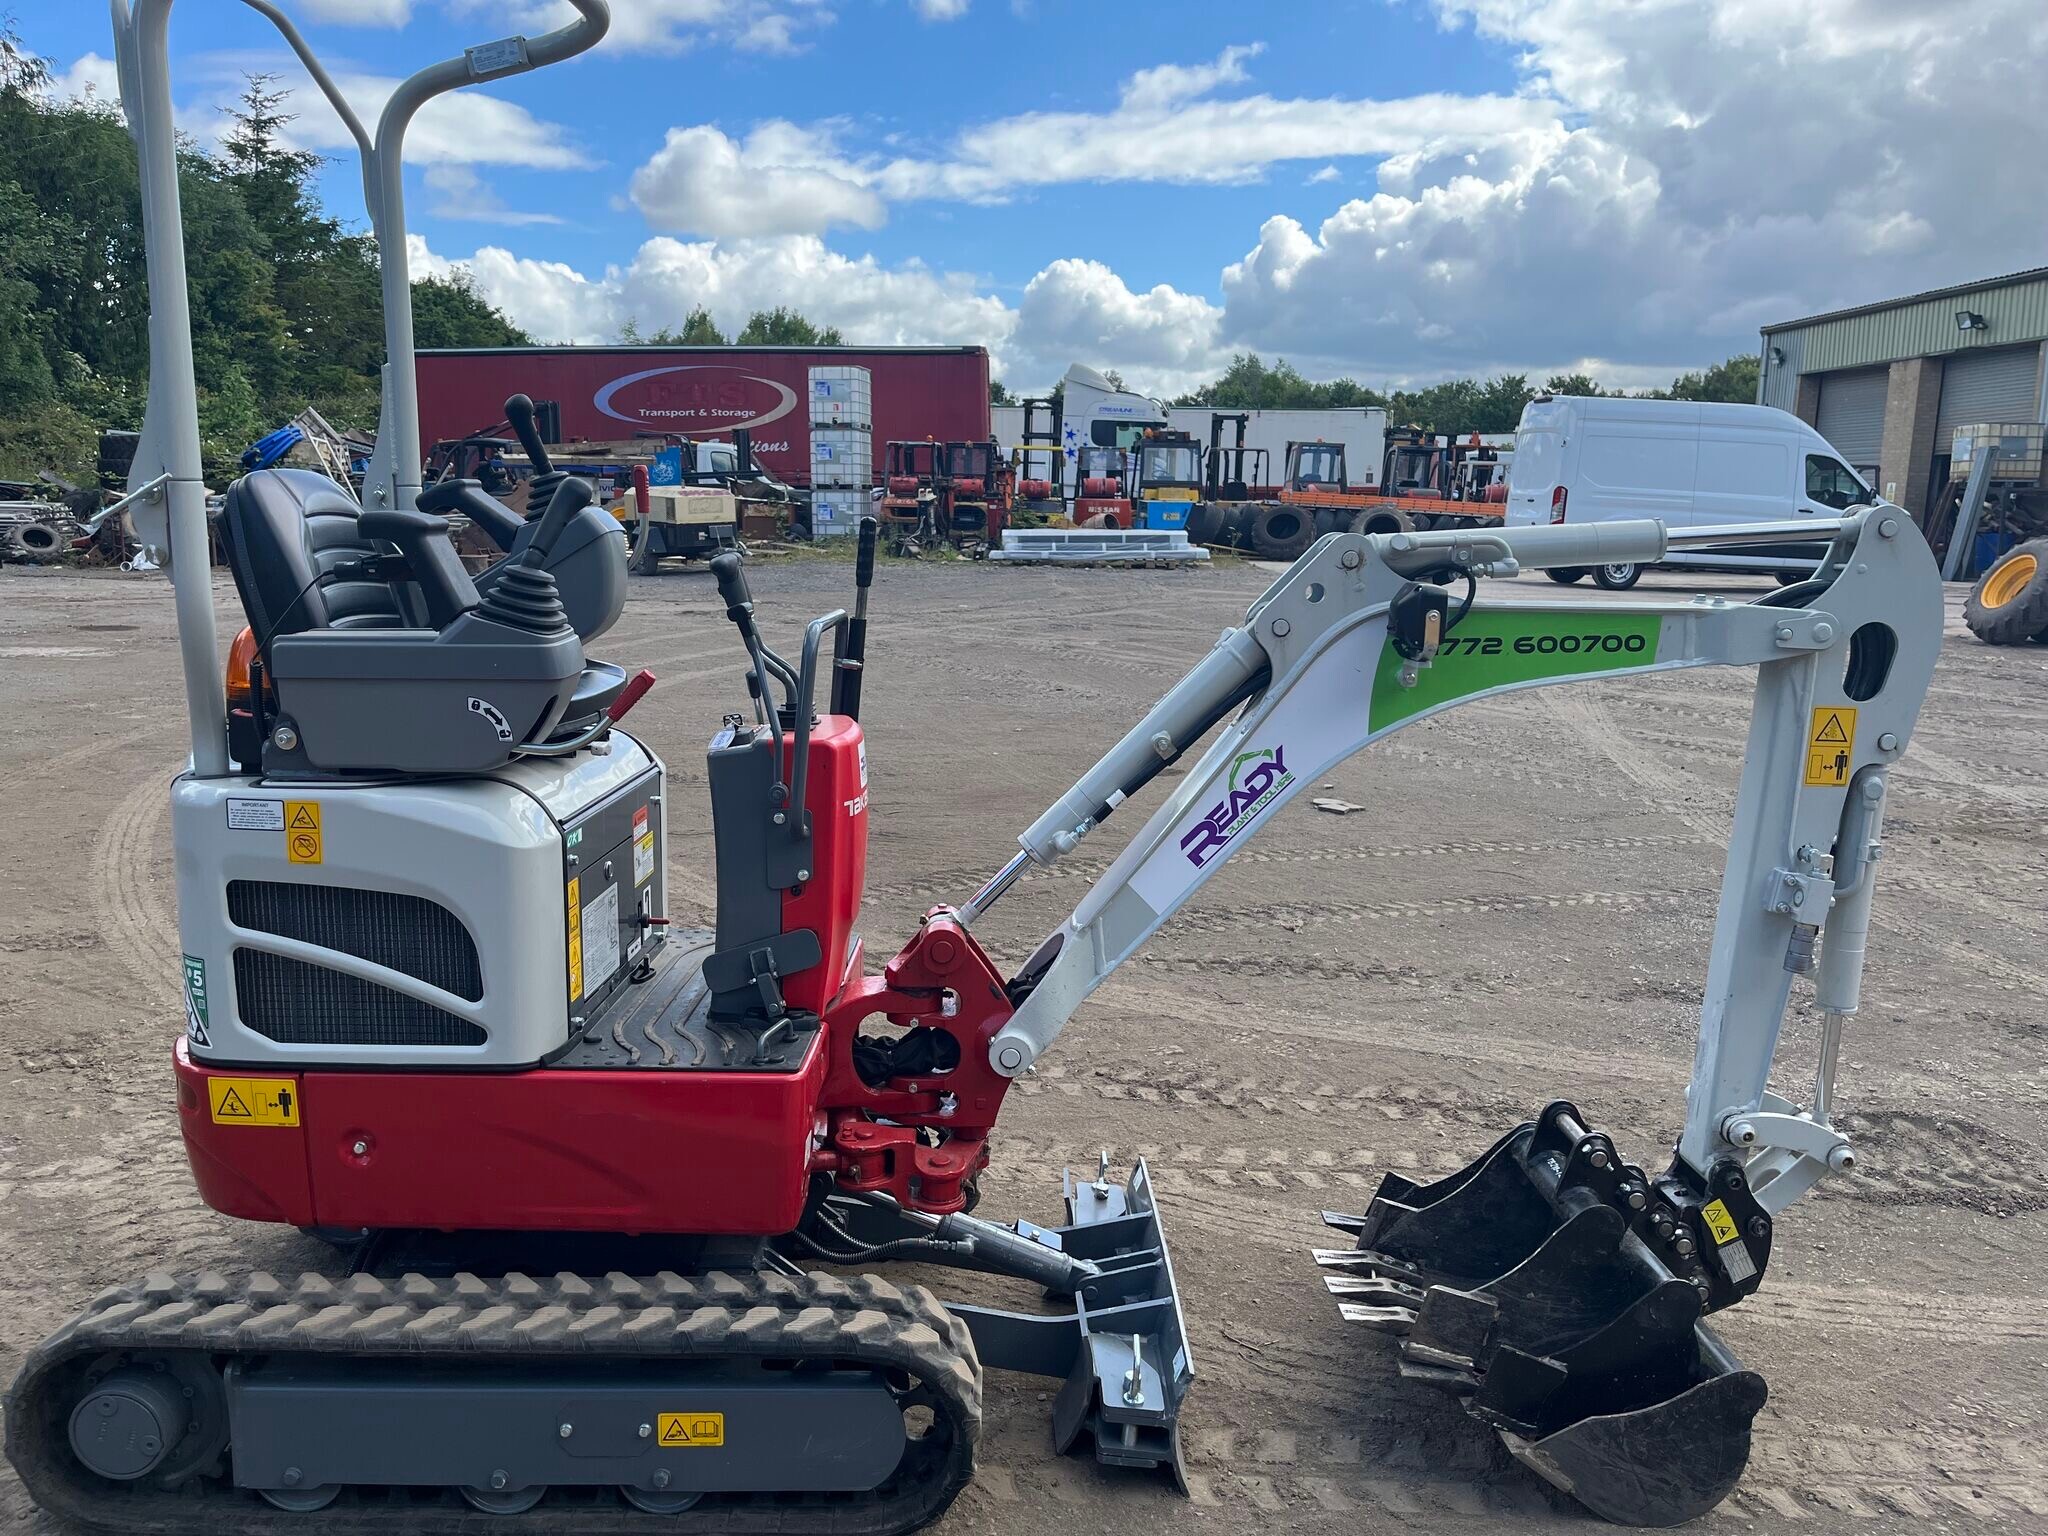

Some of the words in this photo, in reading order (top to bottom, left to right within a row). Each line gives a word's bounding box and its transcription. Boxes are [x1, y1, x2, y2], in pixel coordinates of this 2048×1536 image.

[639, 408, 695, 418] Transport
[699, 409, 706, 417] &
[711, 408, 756, 418] Storage
[1435, 637, 1503, 656] 772
[1513, 634, 1646, 654] 600700
[1180, 745, 1288, 867] READY
[1227, 810, 1251, 835] PLANT
[1257, 788, 1276, 807] TOOL
[1275, 771, 1294, 791] HIRE
[193, 970, 203, 987] 5
